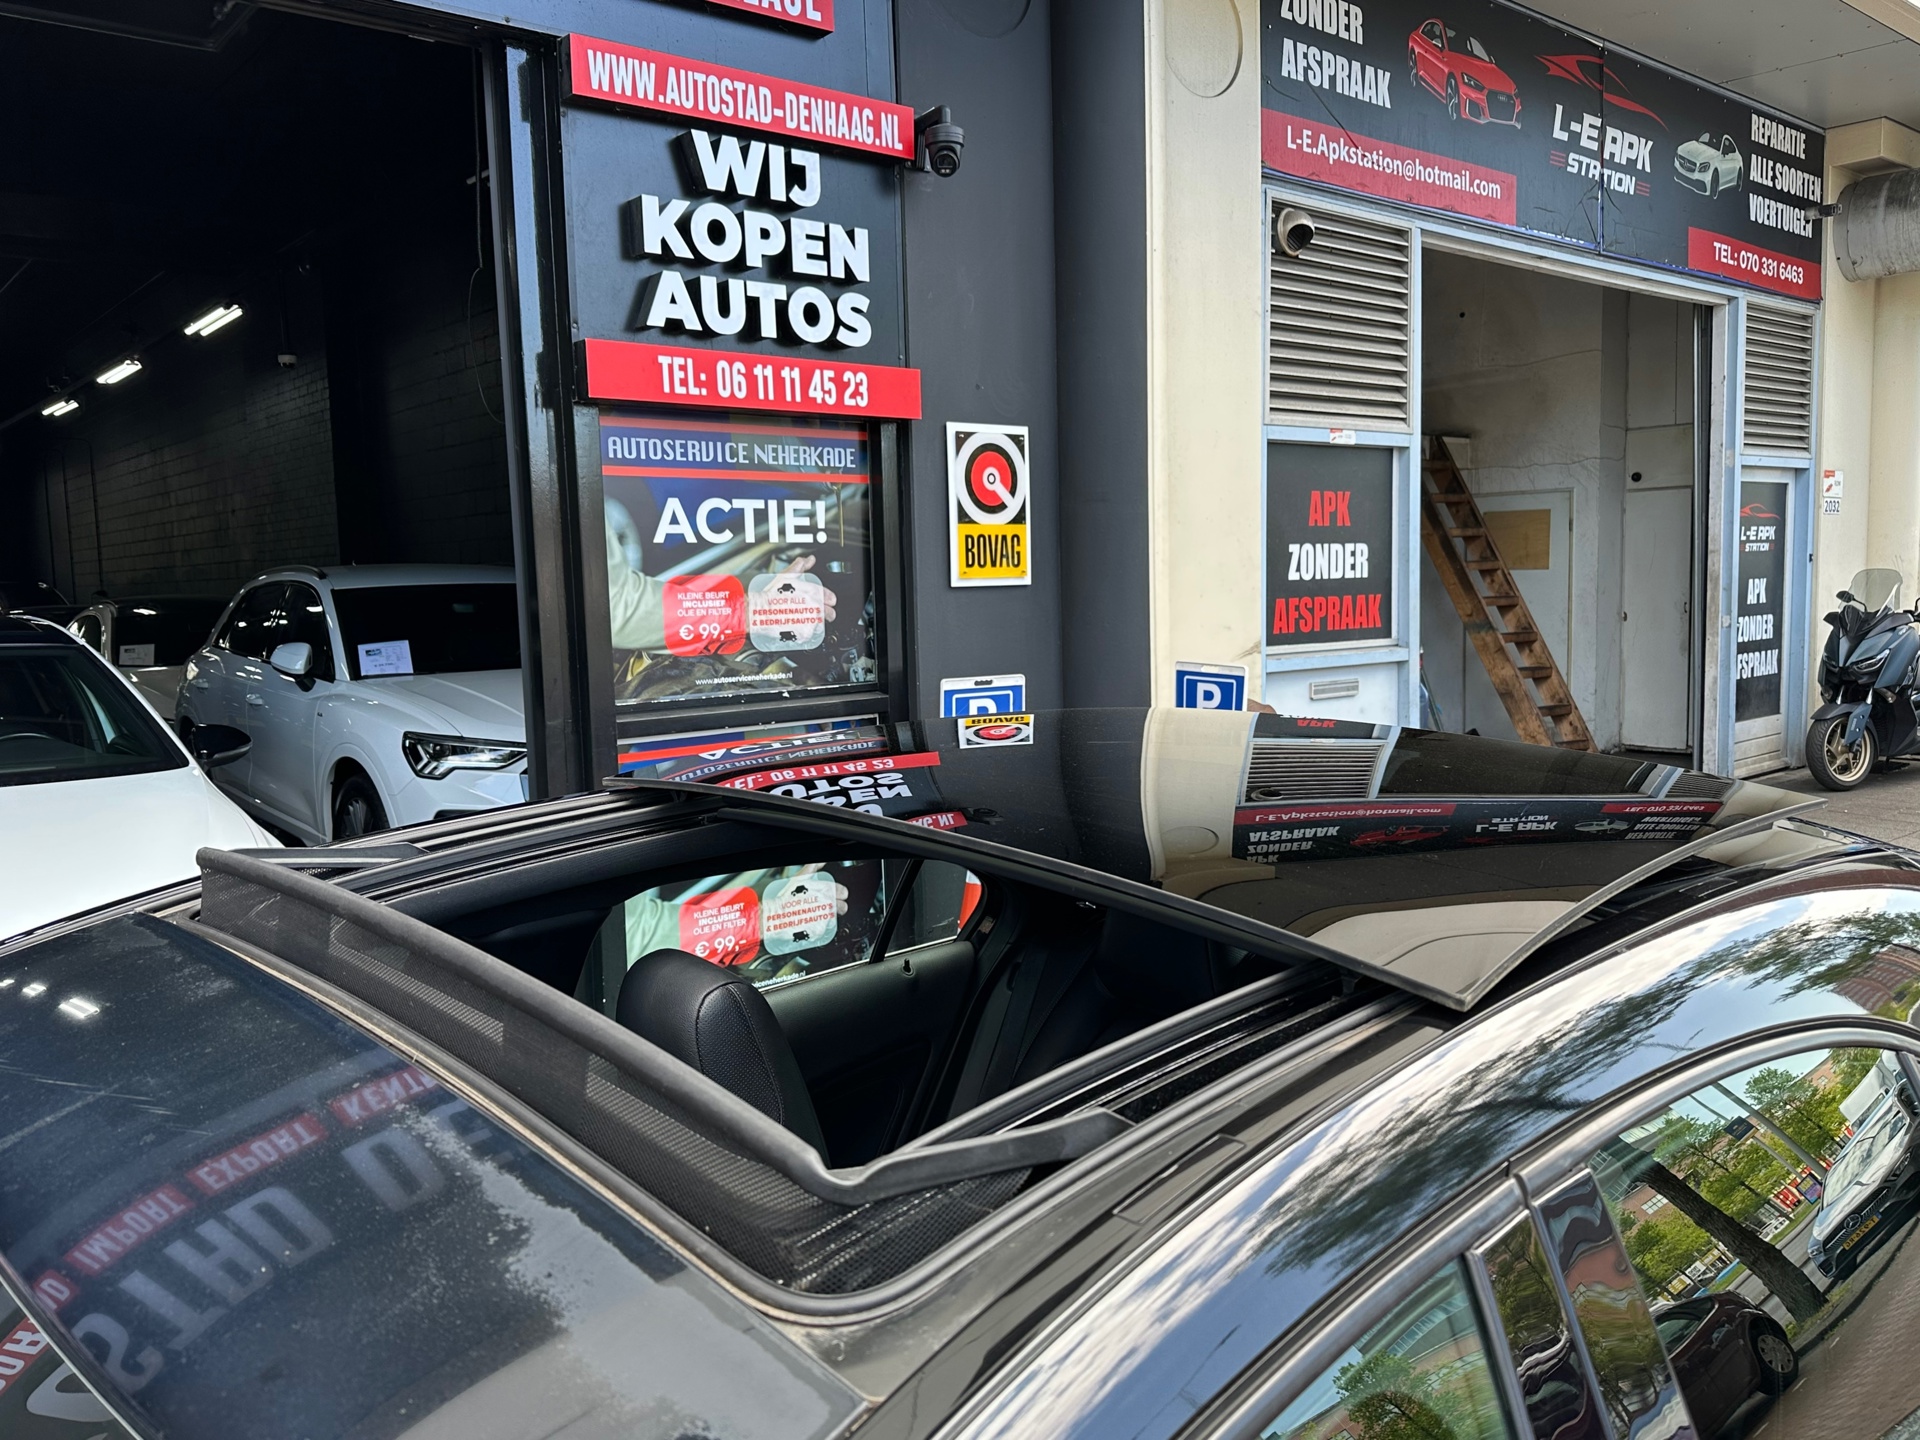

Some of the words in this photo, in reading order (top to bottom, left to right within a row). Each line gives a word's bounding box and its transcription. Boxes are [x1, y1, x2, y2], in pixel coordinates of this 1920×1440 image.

[1281, 37, 1391, 109] AFSPRAAK
[587, 49, 903, 151] WWW.AUTOSTAD-DENHAAG.NL
[1603, 125, 1654, 173] APK
[1751, 113, 1806, 160] REPARATIE
[691, 129, 822, 207] WIJ
[1287, 125, 1501, 199] L-E.Apkstation@hotmail.com
[1566, 152, 1636, 195] STATION
[1749, 154, 1773, 187] ALLE
[1775, 162, 1821, 204] SOORTEN
[641, 194, 870, 282] KOPEN
[1713, 242, 1738, 267] TEL:
[1740, 250, 1760, 273] 070
[1761, 257, 1777, 278] 331
[1779, 262, 1804, 285] 6463
[646, 270, 872, 348] AUTOS
[657, 355, 706, 396] TEL:
[716, 360, 747, 399] 06
[753, 364, 775, 401] 11
[781, 366, 801, 403] 11
[808, 369, 837, 406] 45
[843, 371, 869, 408] 23
[607, 436, 749, 464] AUTOSERVICE
[754, 443, 856, 468] NEHERKADE
[653, 497, 828, 544] ACTIE!
[1308, 490, 1351, 527] APK
[1825, 500, 1839, 513] 2032
[1745, 543, 1769, 551] STATION
[1758, 526, 1776, 540] APK
[965, 534, 1021, 568] BOVAG
[1288, 543, 1369, 581] ZONDER
[682, 600, 726, 608] INCLUSIEF
[705, 591, 730, 599] BEURT
[790, 597, 806, 605] ALLE
[1747, 578, 1767, 604] APK
[677, 609, 695, 617] OLIE
[696, 608, 706, 616] EN
[707, 608, 732, 616] FILTER
[753, 608, 821, 616] PERSONENAUTO'S
[760, 617, 823, 626] BEDRIJFSAUTO'S
[1273, 594, 1382, 635] AFSPRAAK
[679, 625, 695, 641] €
[1737, 614, 1773, 642] ZONDER
[695, 672, 793, 686] www.autoserviceneherkade.nl
[1736, 649, 1778, 680] FSPRAAK
[693, 908, 719, 919] KLEINE
[720, 903, 744, 914] BEURT
[767, 903, 833, 922] PERSONENAUTO'S
[782, 899, 801, 909] VOOR
[803, 896, 818, 905] ALLE
[698, 912, 741, 926] INCLUSIEF
[712, 923, 722, 932] EN
[724, 918, 746, 929] FILTER
[695, 941, 710, 957] €
